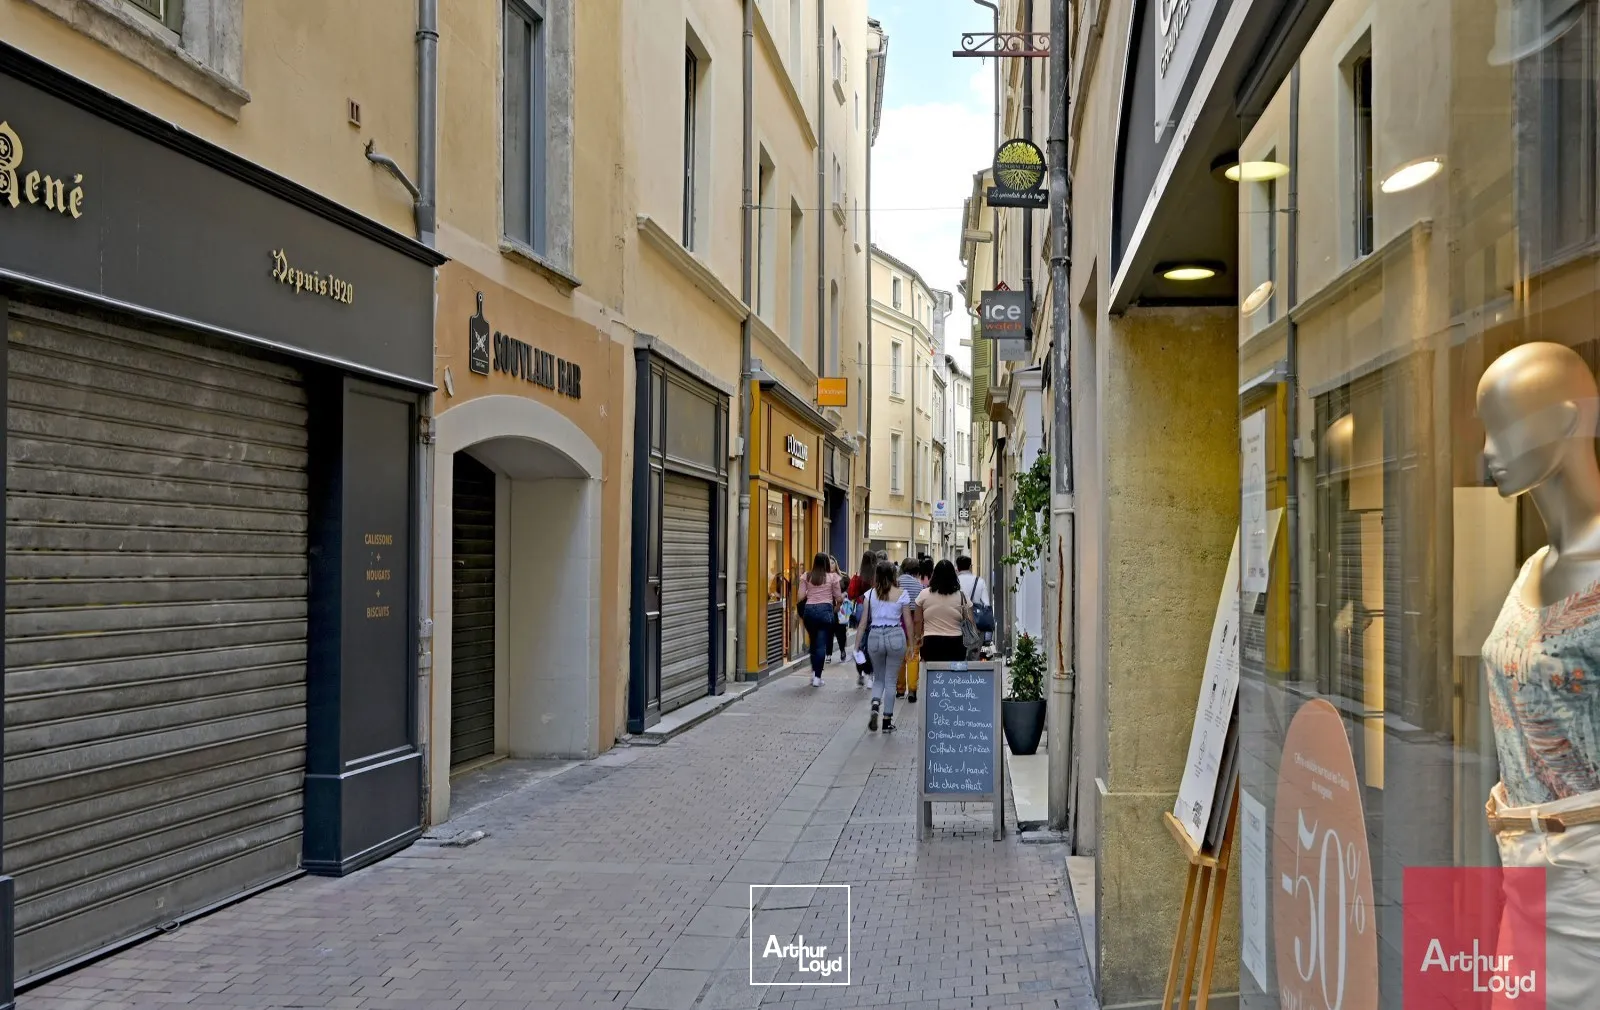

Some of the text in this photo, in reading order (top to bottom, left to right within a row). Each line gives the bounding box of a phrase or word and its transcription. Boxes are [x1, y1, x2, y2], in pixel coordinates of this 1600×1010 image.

[271, 247, 354, 305] Depuis 1920
[493, 331, 582, 400] SOUVLAKI BAR
[364, 533, 393, 545] CALISSONS
[366, 569, 391, 581] NOUGATS
[366, 606, 390, 618] BISCUITS
